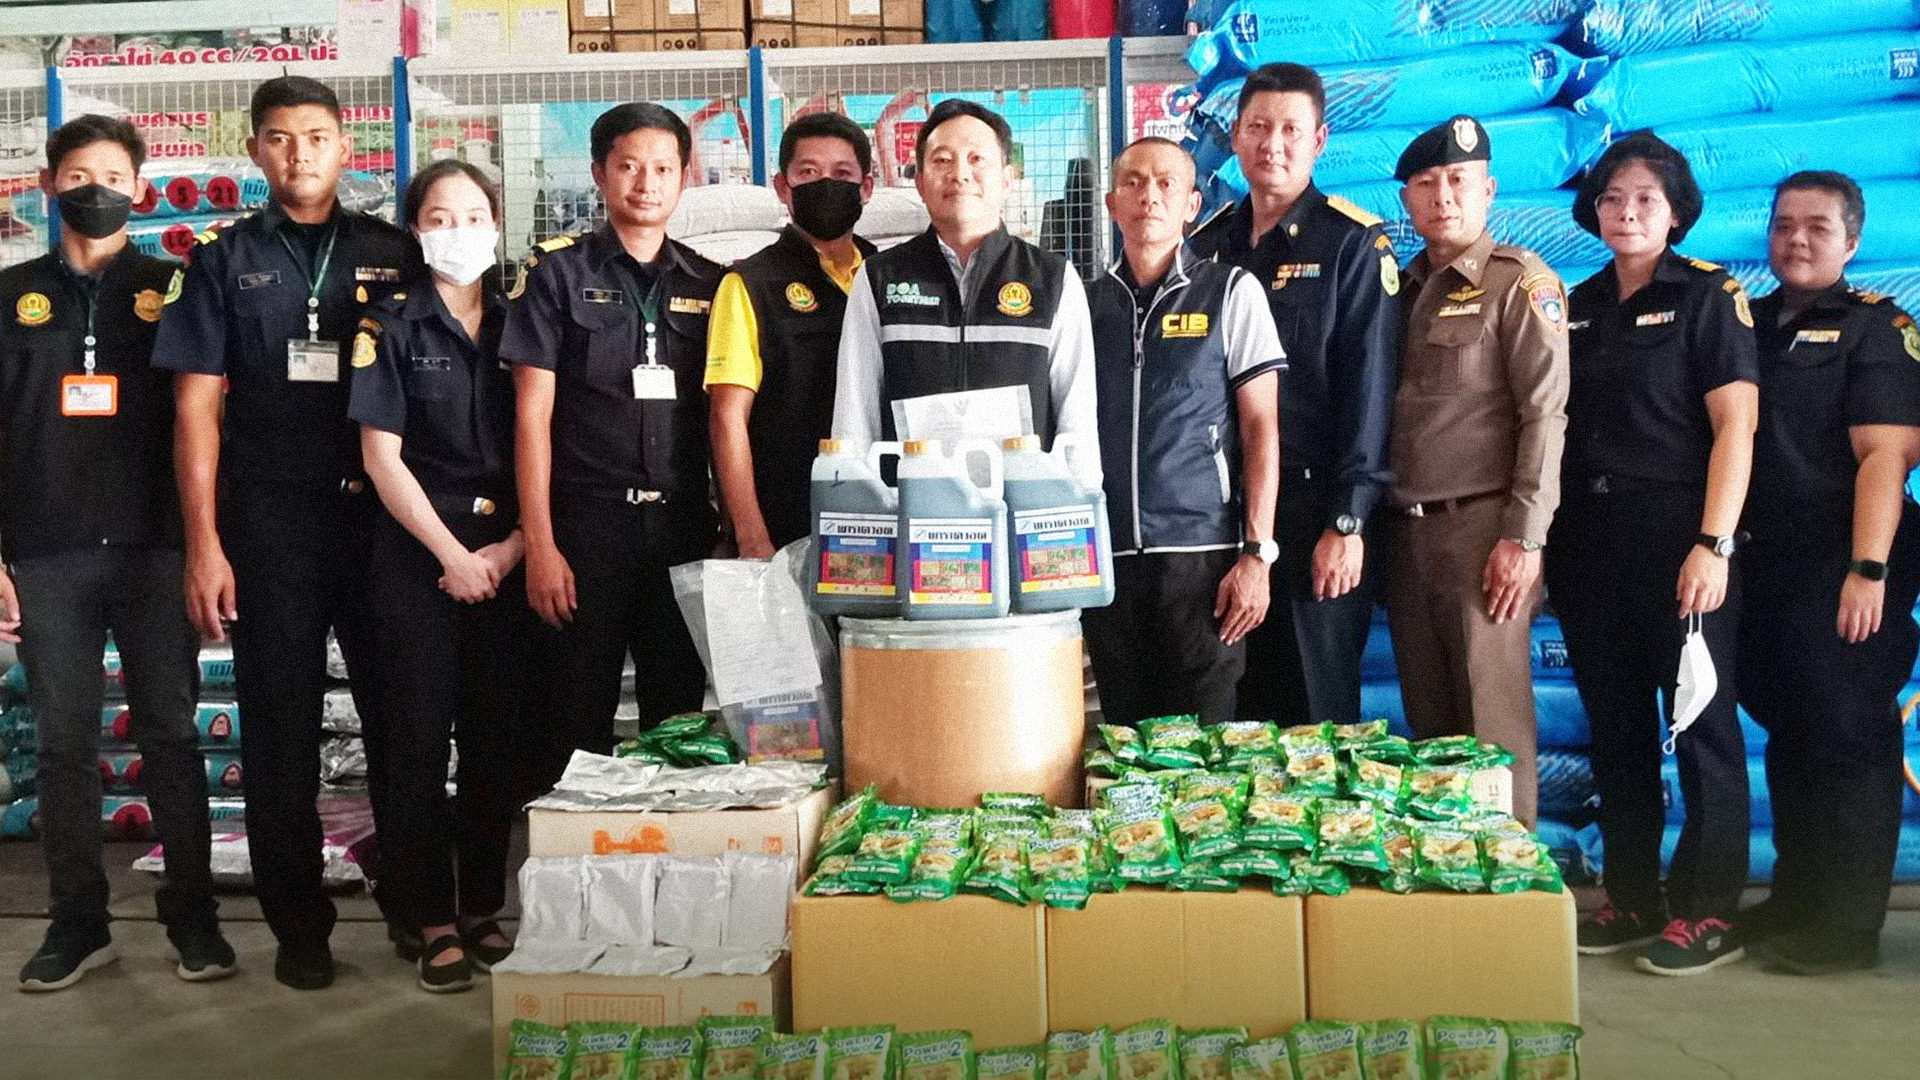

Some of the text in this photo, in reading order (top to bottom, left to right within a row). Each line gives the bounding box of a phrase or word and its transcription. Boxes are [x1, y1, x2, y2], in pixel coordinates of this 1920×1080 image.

[160, 50, 196, 64] 40
[886, 281, 920, 295] DOA
[1162, 313, 1209, 331] CIB
[616, 1033, 628, 1049] 2
[706, 1027, 762, 1042] POWER 2
[873, 1034, 885, 1050] 2
[1154, 1030, 1165, 1046] 2
[1344, 1028, 1355, 1045] 2
[1398, 1030, 1409, 1046] 2
[1437, 1029, 1498, 1045] POWER 2
[518, 1036, 567, 1055] POWER 2
[680, 1038, 691, 1054] 2
[807, 1037, 819, 1054] 2
[903, 1041, 961, 1059] POWER 2
[1276, 1040, 1288, 1057] 2
[1023, 1053, 1034, 1068] 2
